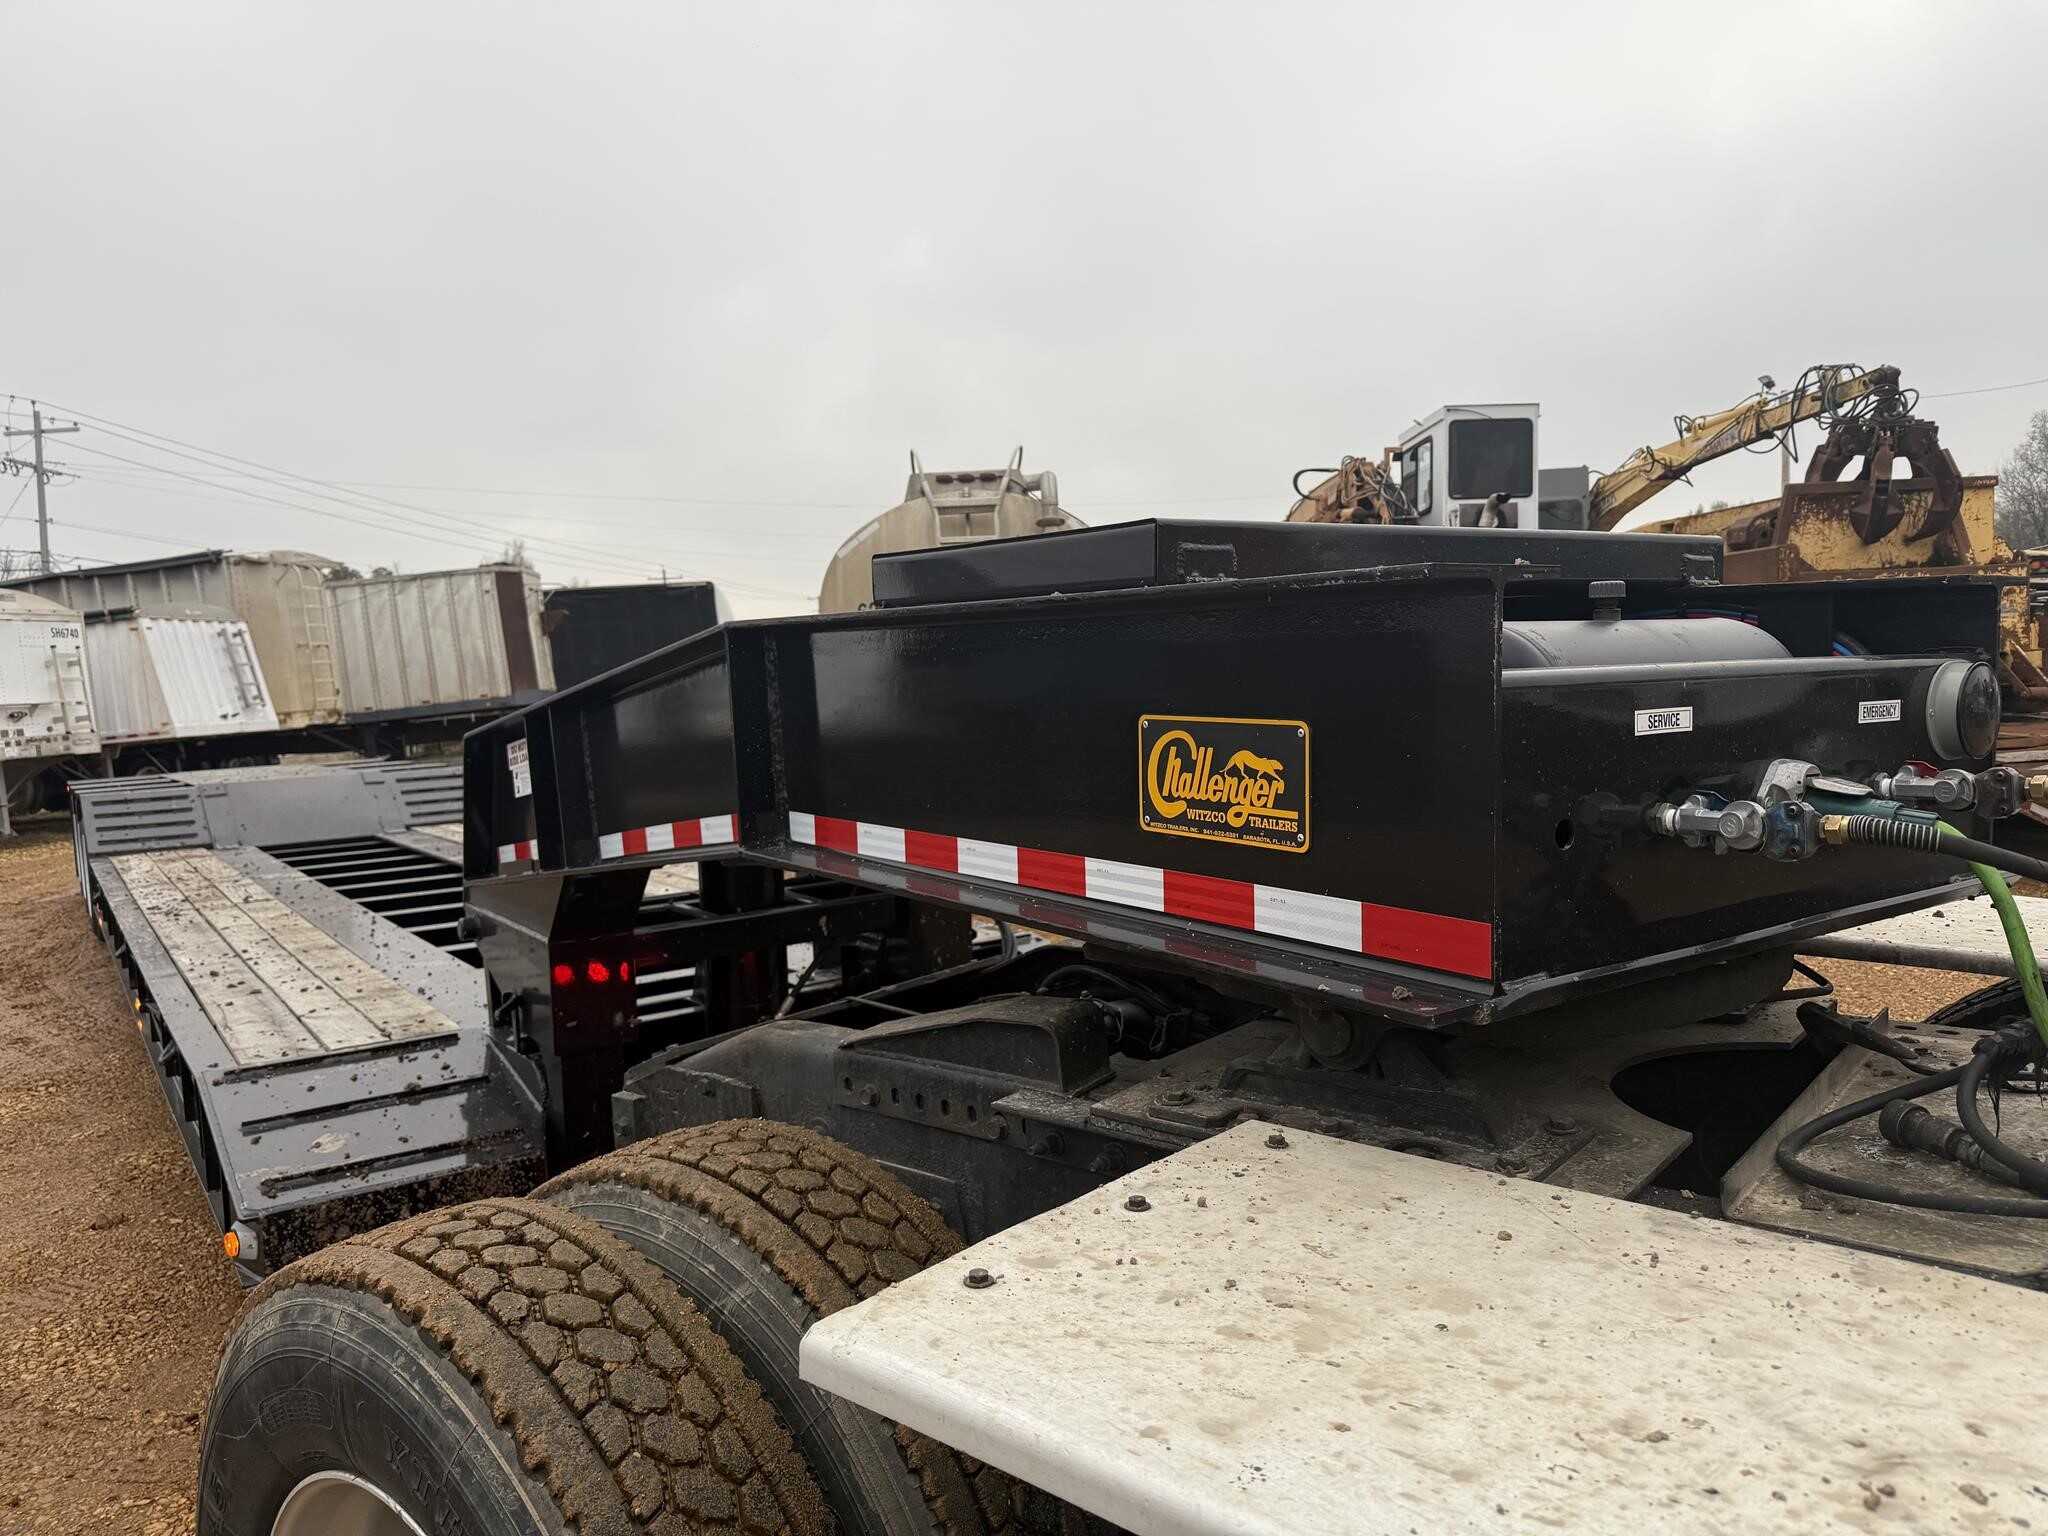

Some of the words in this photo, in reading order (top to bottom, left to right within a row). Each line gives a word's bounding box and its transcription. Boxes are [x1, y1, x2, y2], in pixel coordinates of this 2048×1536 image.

[50, 627, 79, 639] SH6740
[1862, 704, 1897, 719] EMERGENCY
[1647, 712, 1681, 729] SERVICE
[1148, 729, 1299, 828] Challenger
[1186, 807, 1226, 824] WITZCO
[1248, 815, 1299, 833] TRAILERS
